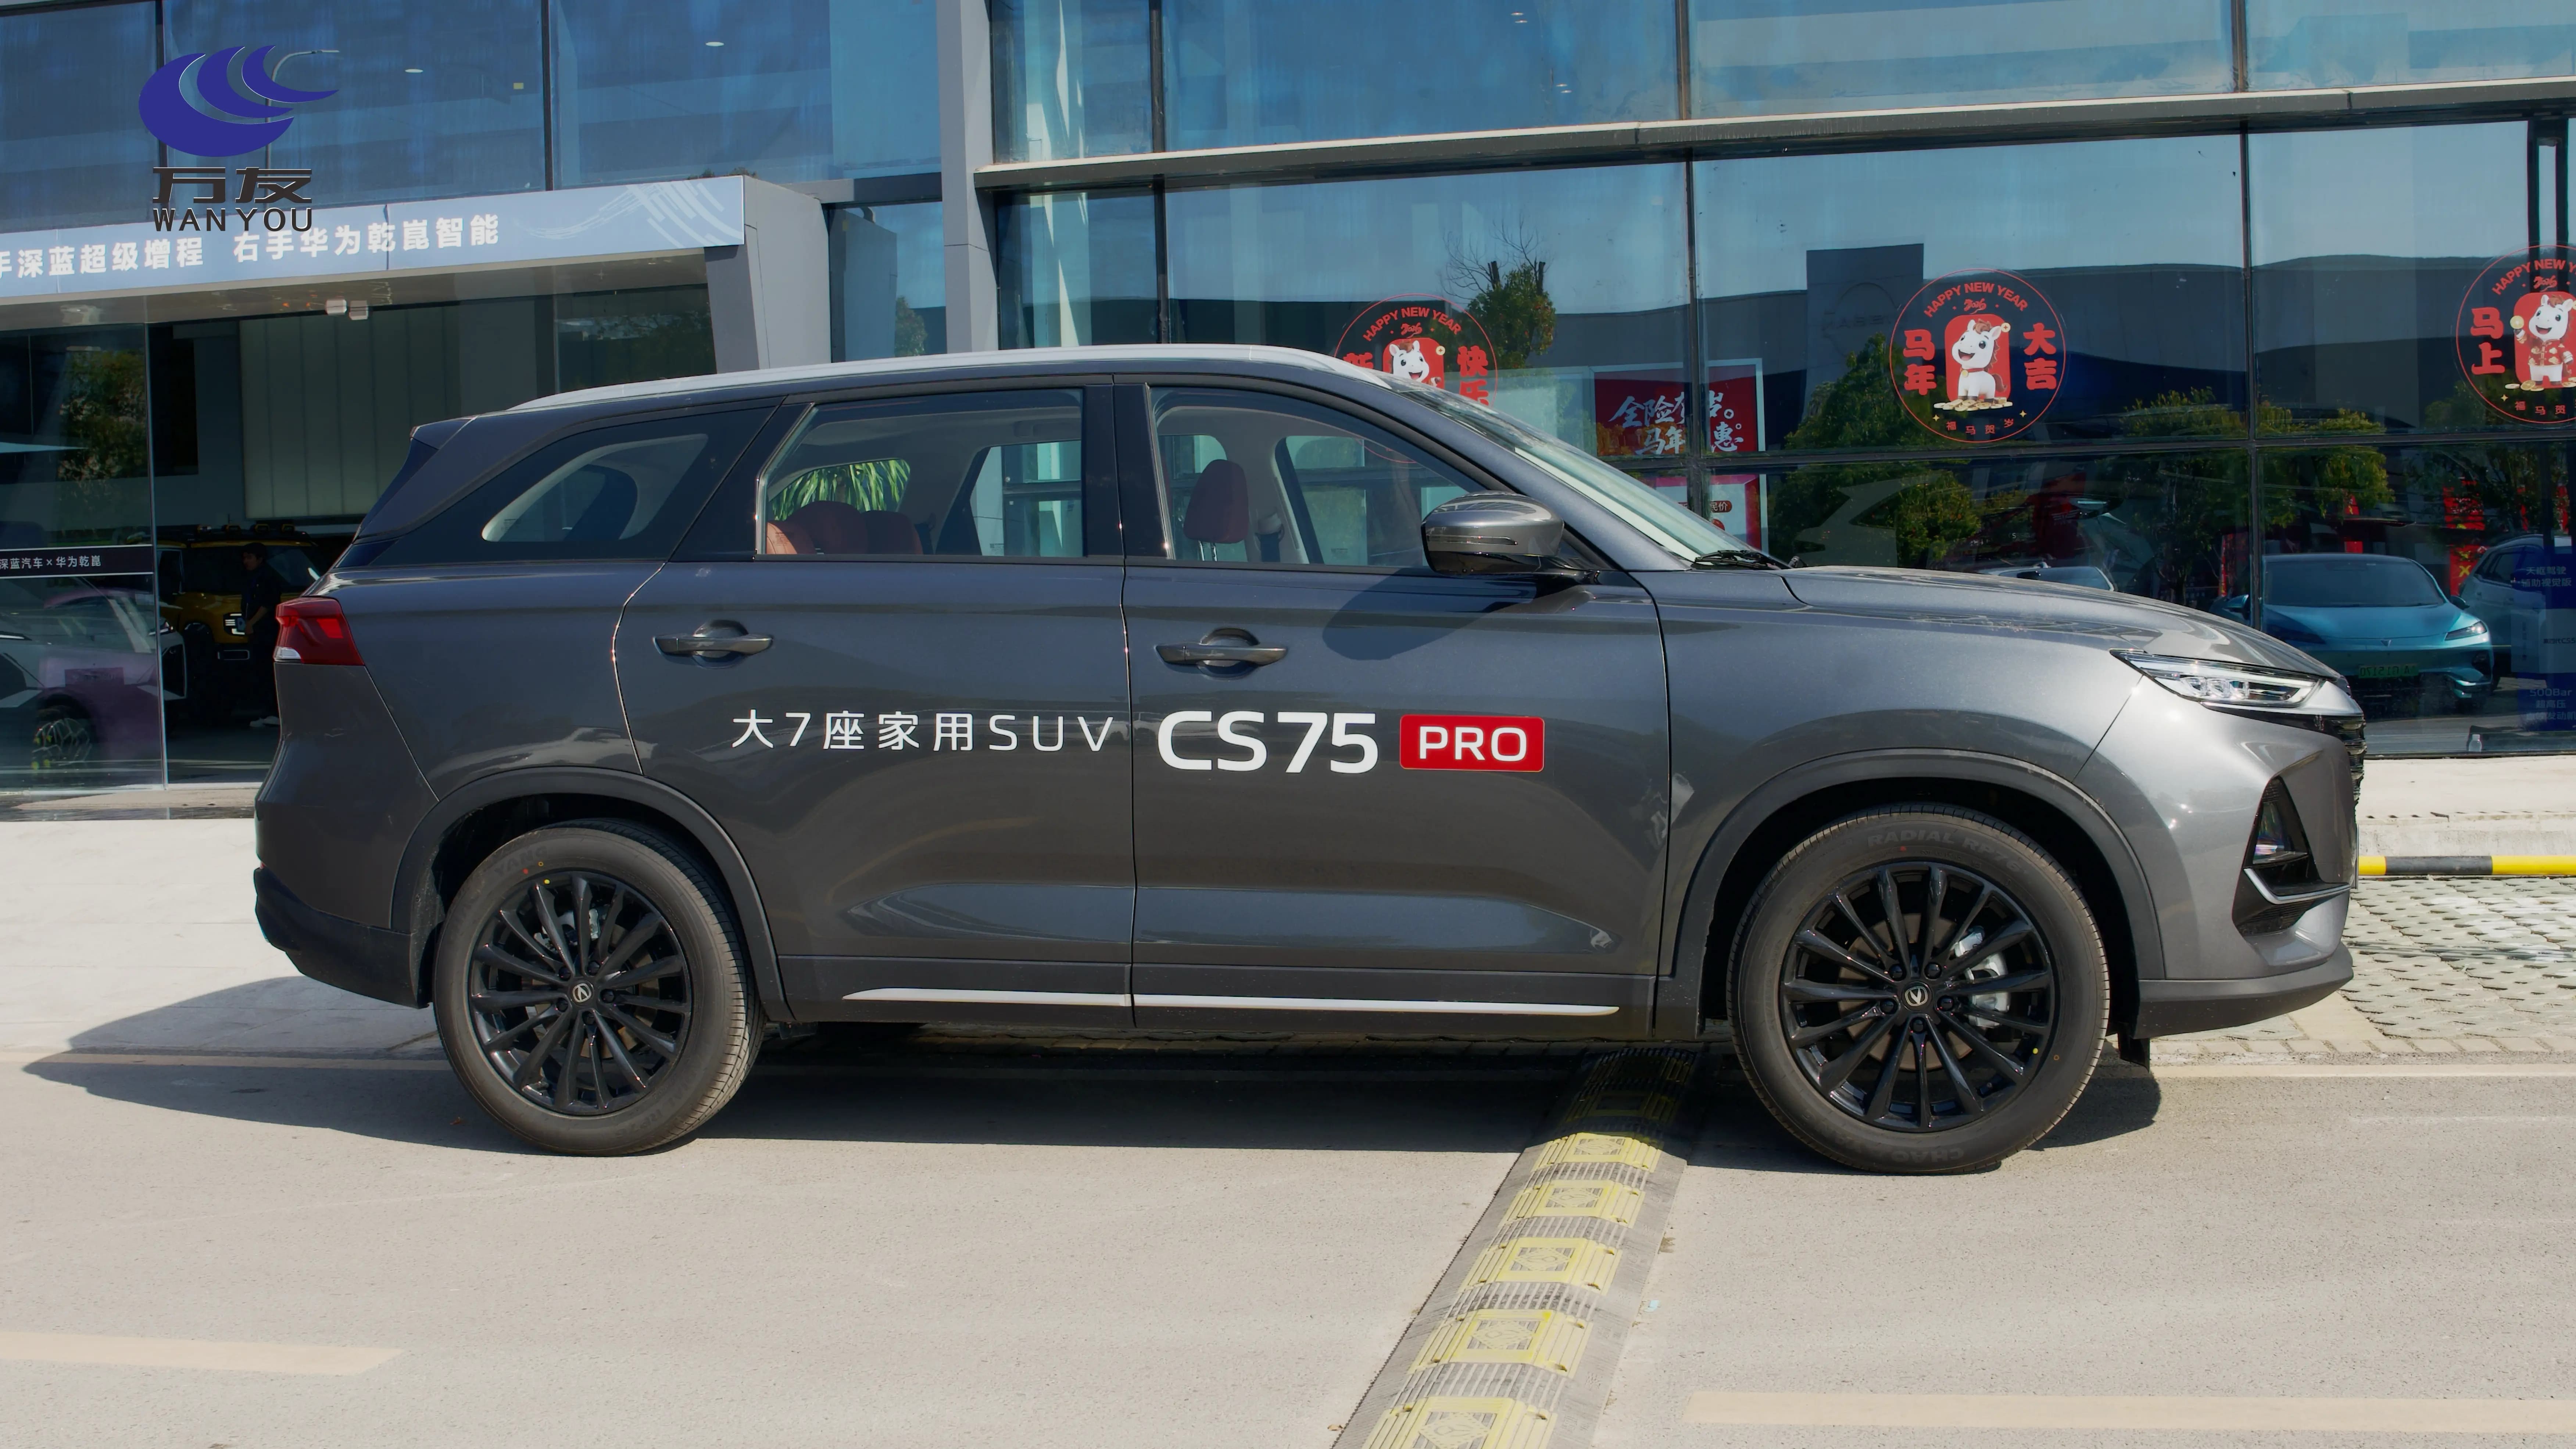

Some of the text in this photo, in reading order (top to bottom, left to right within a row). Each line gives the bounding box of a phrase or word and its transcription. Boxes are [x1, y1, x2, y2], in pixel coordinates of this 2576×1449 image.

[2491, 262, 2531, 295] HAPPY
[2534, 259, 2566, 271] NEW
[1924, 282, 2028, 318] HAPPY NEW YEAR
[1363, 307, 1462, 341] HAPPY NEW YEAR
[2470, 307, 2505, 375] 马上
[1903, 329, 1937, 396] 马年
[2023, 322, 2057, 390] 大吉
[1457, 345, 1489, 406] 快乐
[2515, 401, 2576, 415] 福马贺
[1635, 422, 1744, 455] 马年惠
[1946, 418, 2014, 435] 福马贺岁
[732, 709, 1114, 752] 大7座家用SUV
[1157, 710, 1527, 774] CS75 PRO
[1867, 829, 1954, 847] RADIAL
